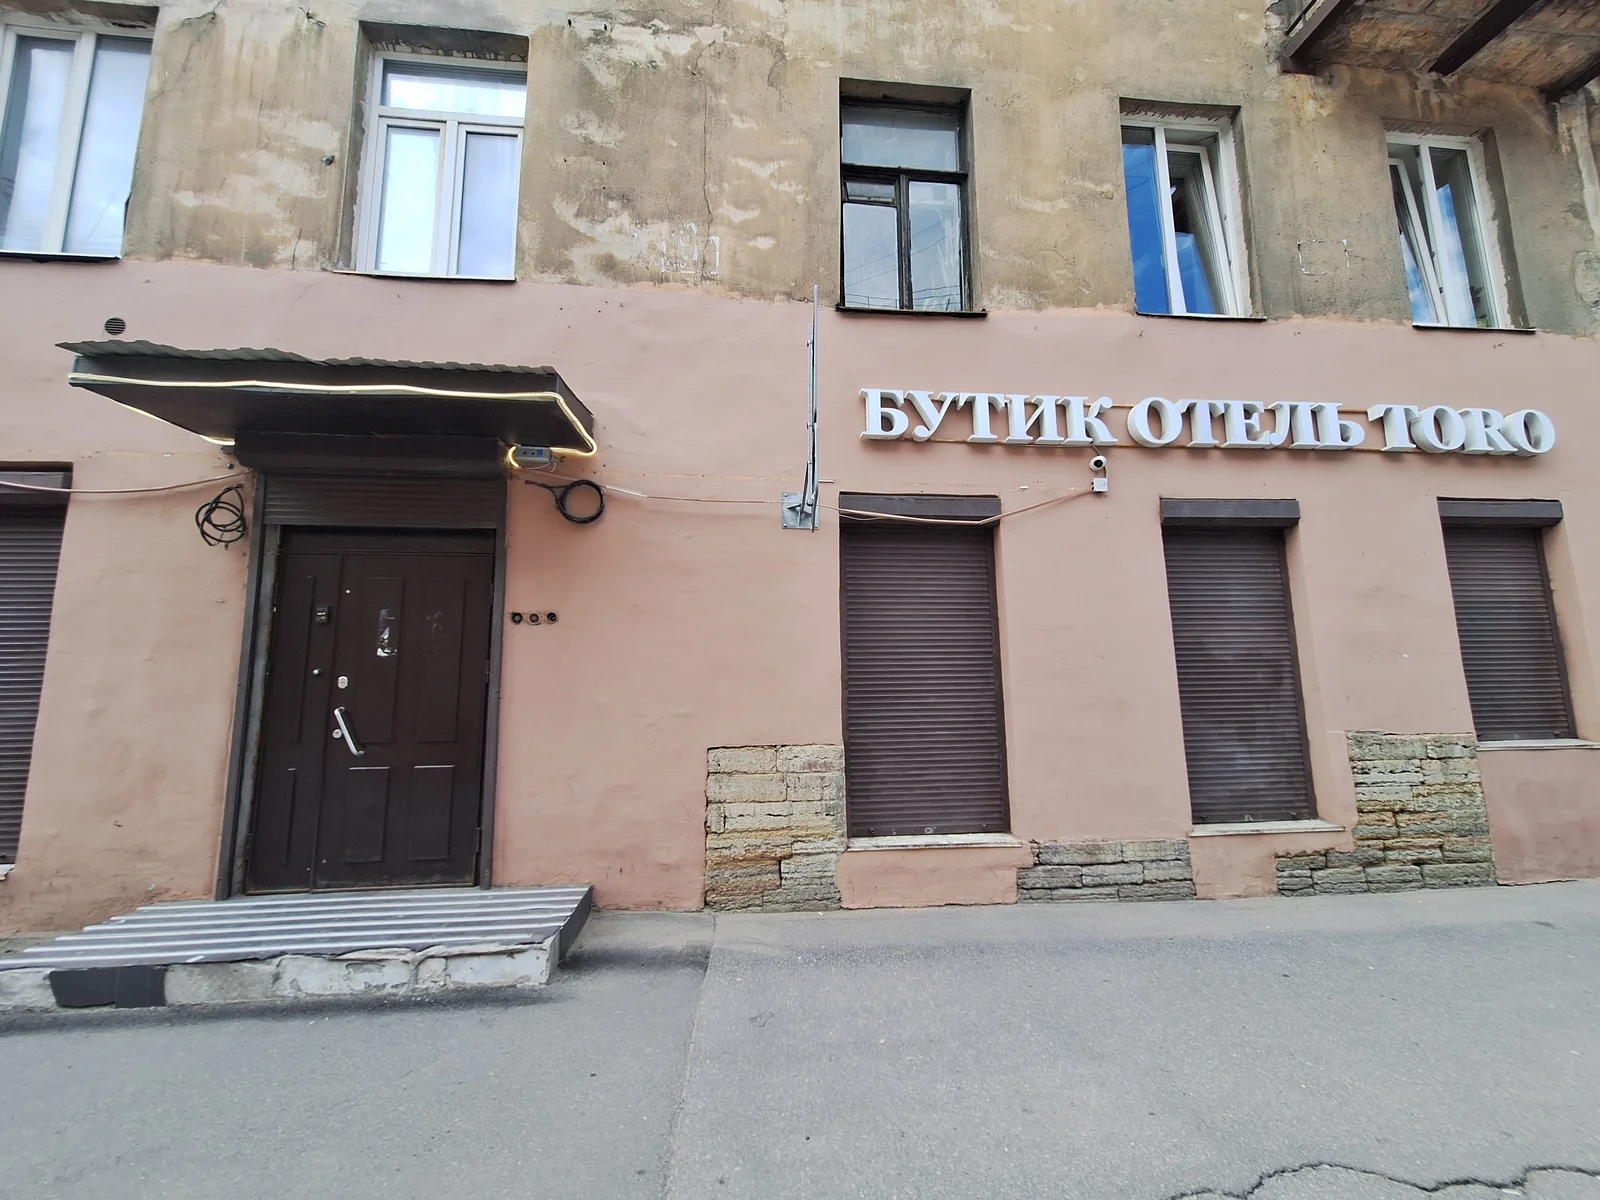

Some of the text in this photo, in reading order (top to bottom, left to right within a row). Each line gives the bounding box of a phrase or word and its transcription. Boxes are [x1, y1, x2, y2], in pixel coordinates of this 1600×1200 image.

[858, 387, 1556, 457] БУТИК ОТЕЛЬ TORO
